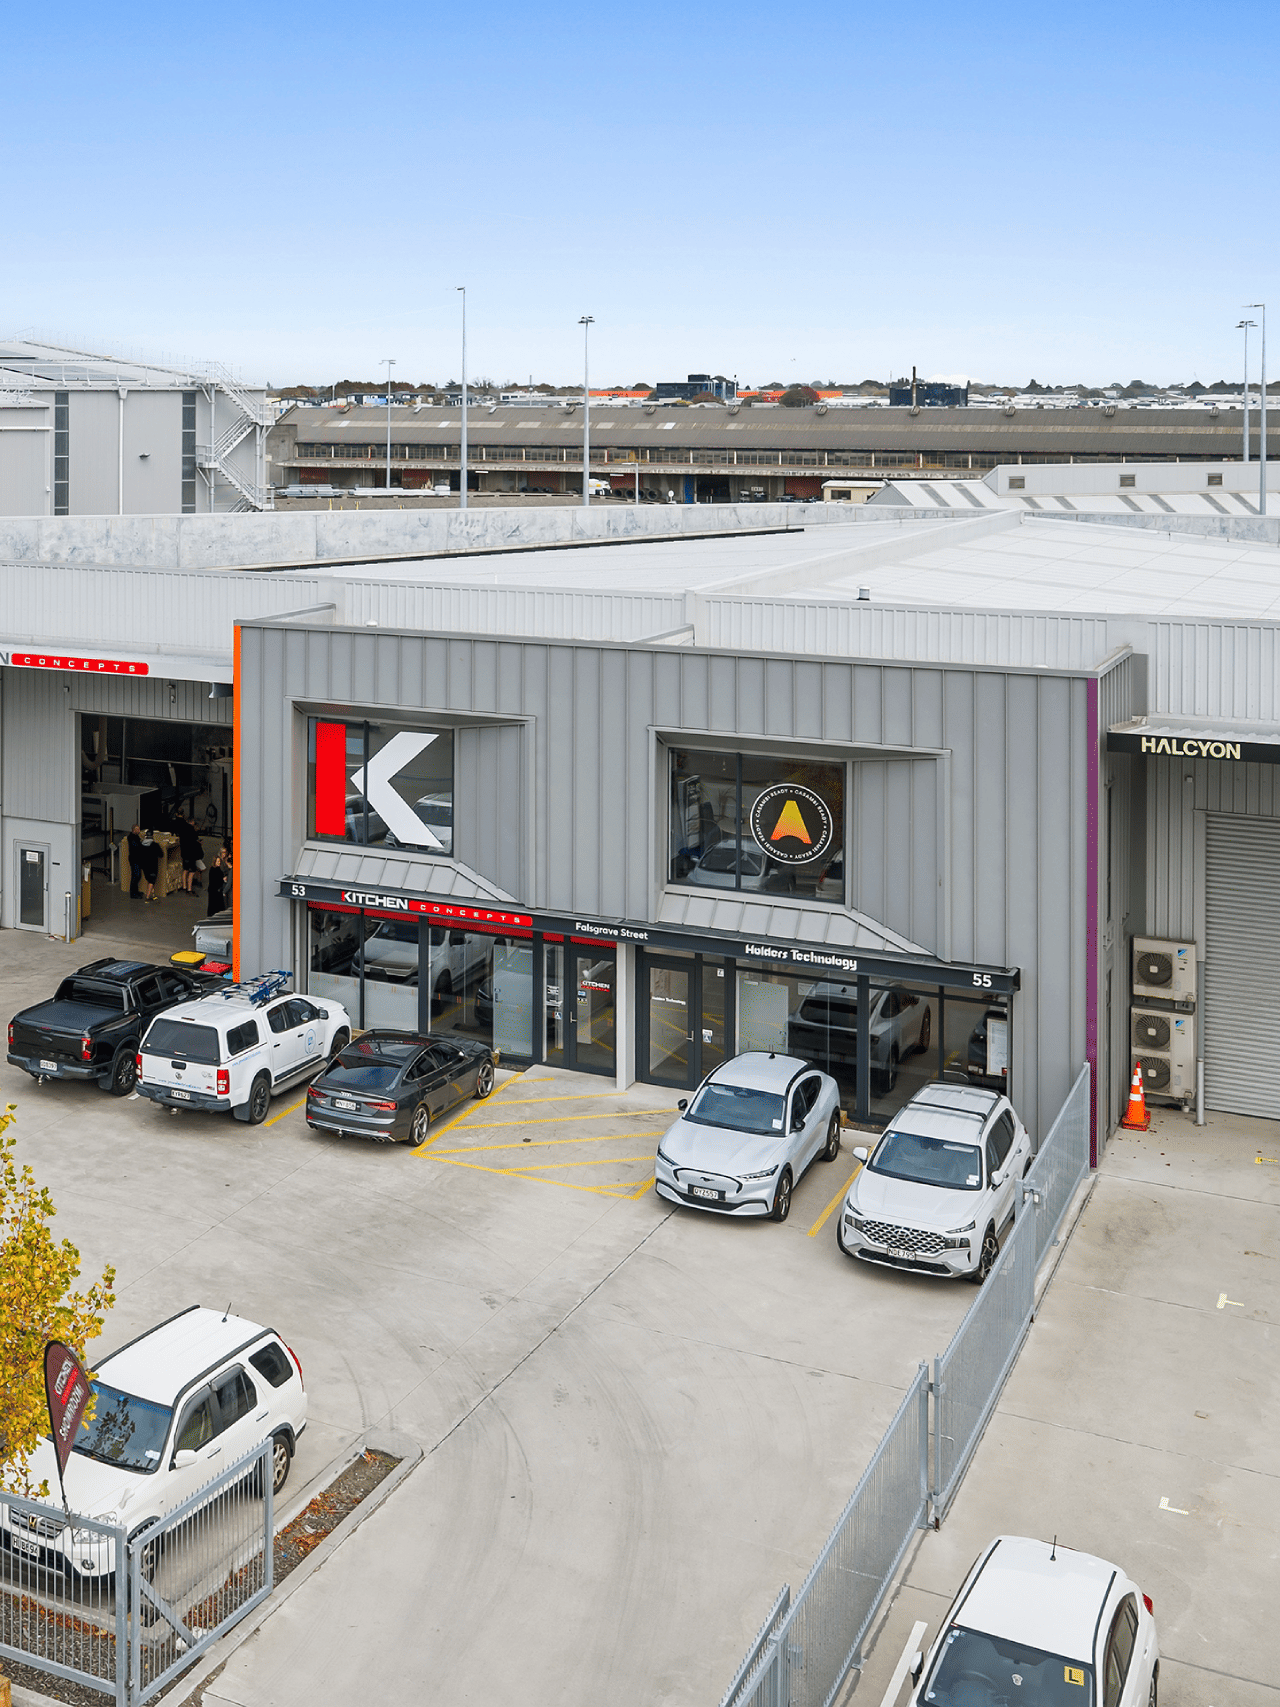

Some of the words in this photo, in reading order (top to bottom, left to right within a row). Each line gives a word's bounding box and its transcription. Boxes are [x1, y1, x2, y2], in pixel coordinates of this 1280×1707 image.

[24, 656, 135, 672] CONCEPTS
[1141, 736, 1241, 760] HALCYON
[291, 885, 306, 897] 53
[341, 891, 408, 910] KITCHEN
[420, 904, 520, 923] CONCEPTS
[575, 922, 619, 936] Falsgrave
[620, 928, 649, 940] Street
[745, 944, 788, 960] Holders
[790, 949, 858, 971] Technology
[972, 973, 993, 988] 55
[60, 1382, 85, 1441] SHOWROOM
[1068, 1668, 1080, 1683] L
